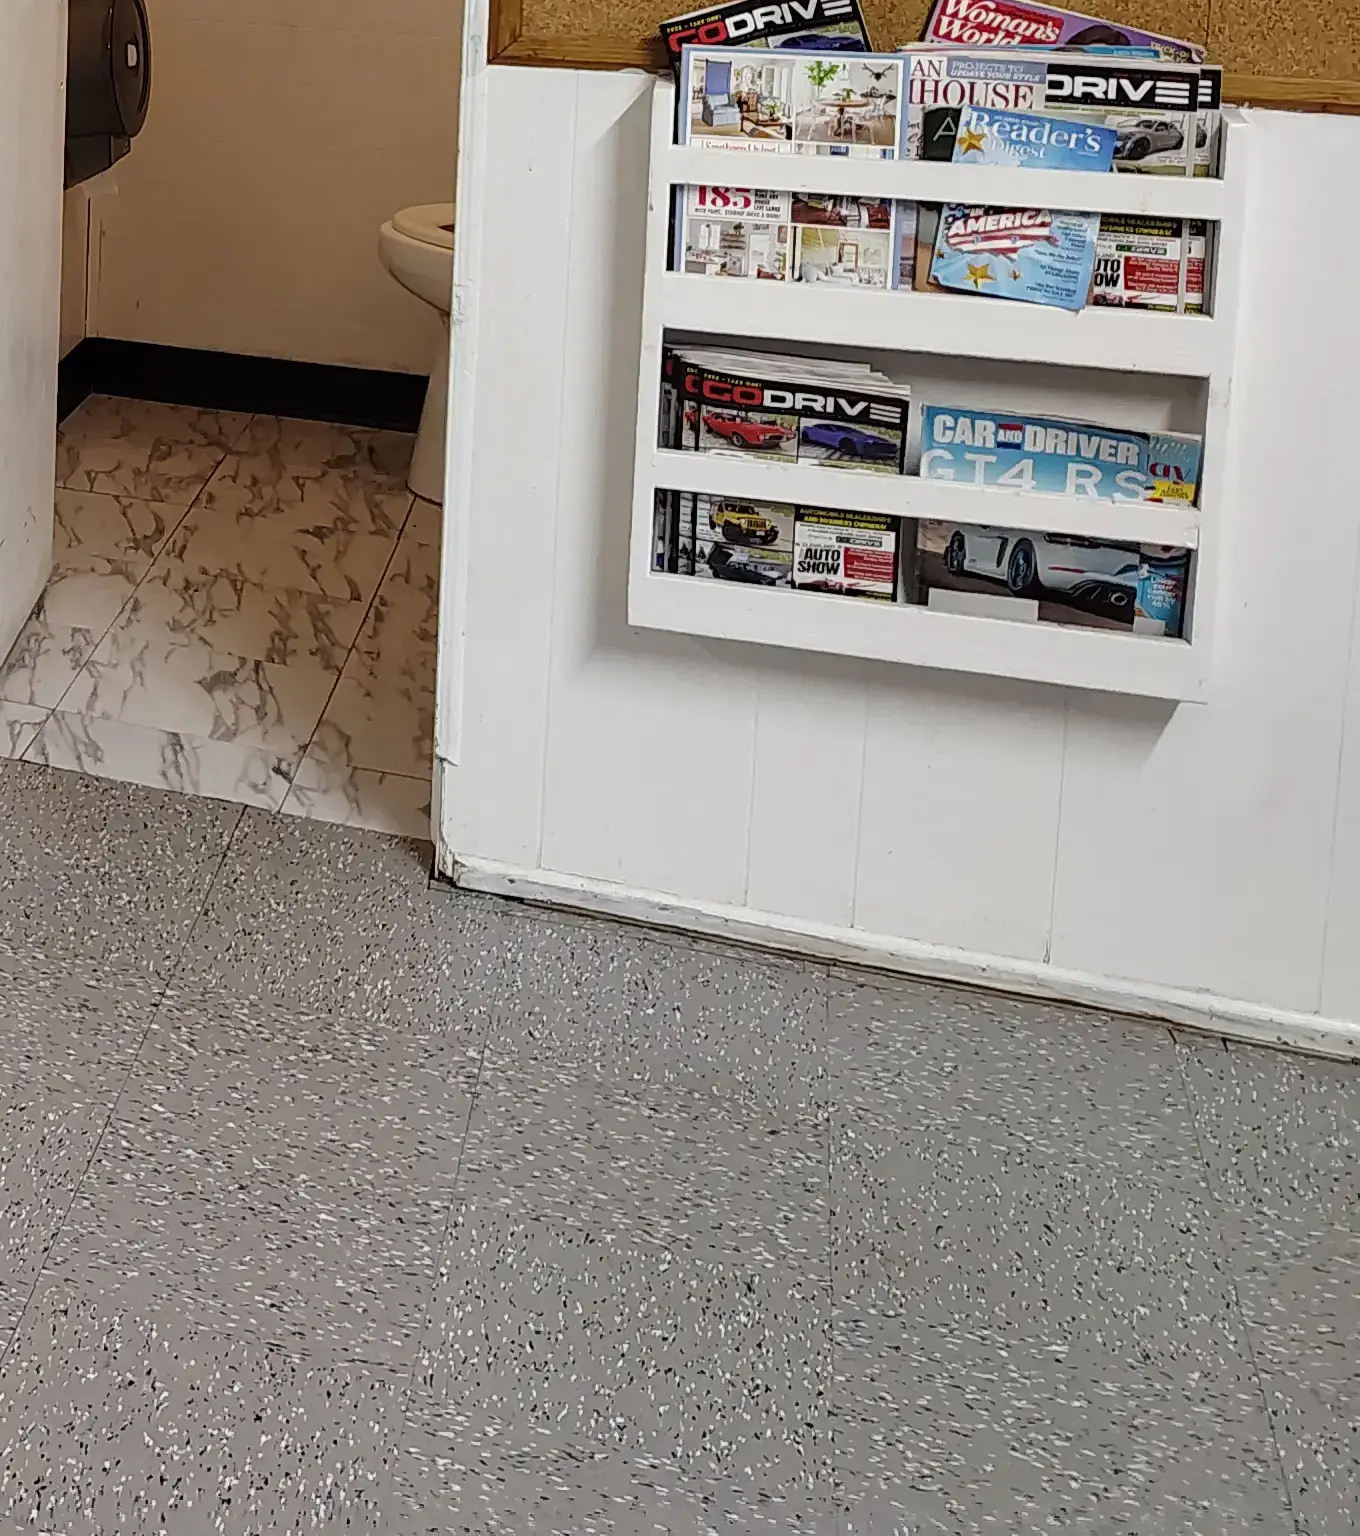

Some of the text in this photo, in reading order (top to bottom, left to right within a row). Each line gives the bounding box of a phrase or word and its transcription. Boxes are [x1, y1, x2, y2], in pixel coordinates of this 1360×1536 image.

[937, 15, 1022, 45] World
[1008, 64, 1023, 72] TO
[968, 108, 1102, 154] Reader's
[991, 139, 1046, 160] Digest
[948, 209, 1052, 236] AMERICA
[933, 415, 1140, 465] CAR AND DRIVER
[804, 548, 840, 561] AUTO
[797, 560, 840, 576] SHOW
